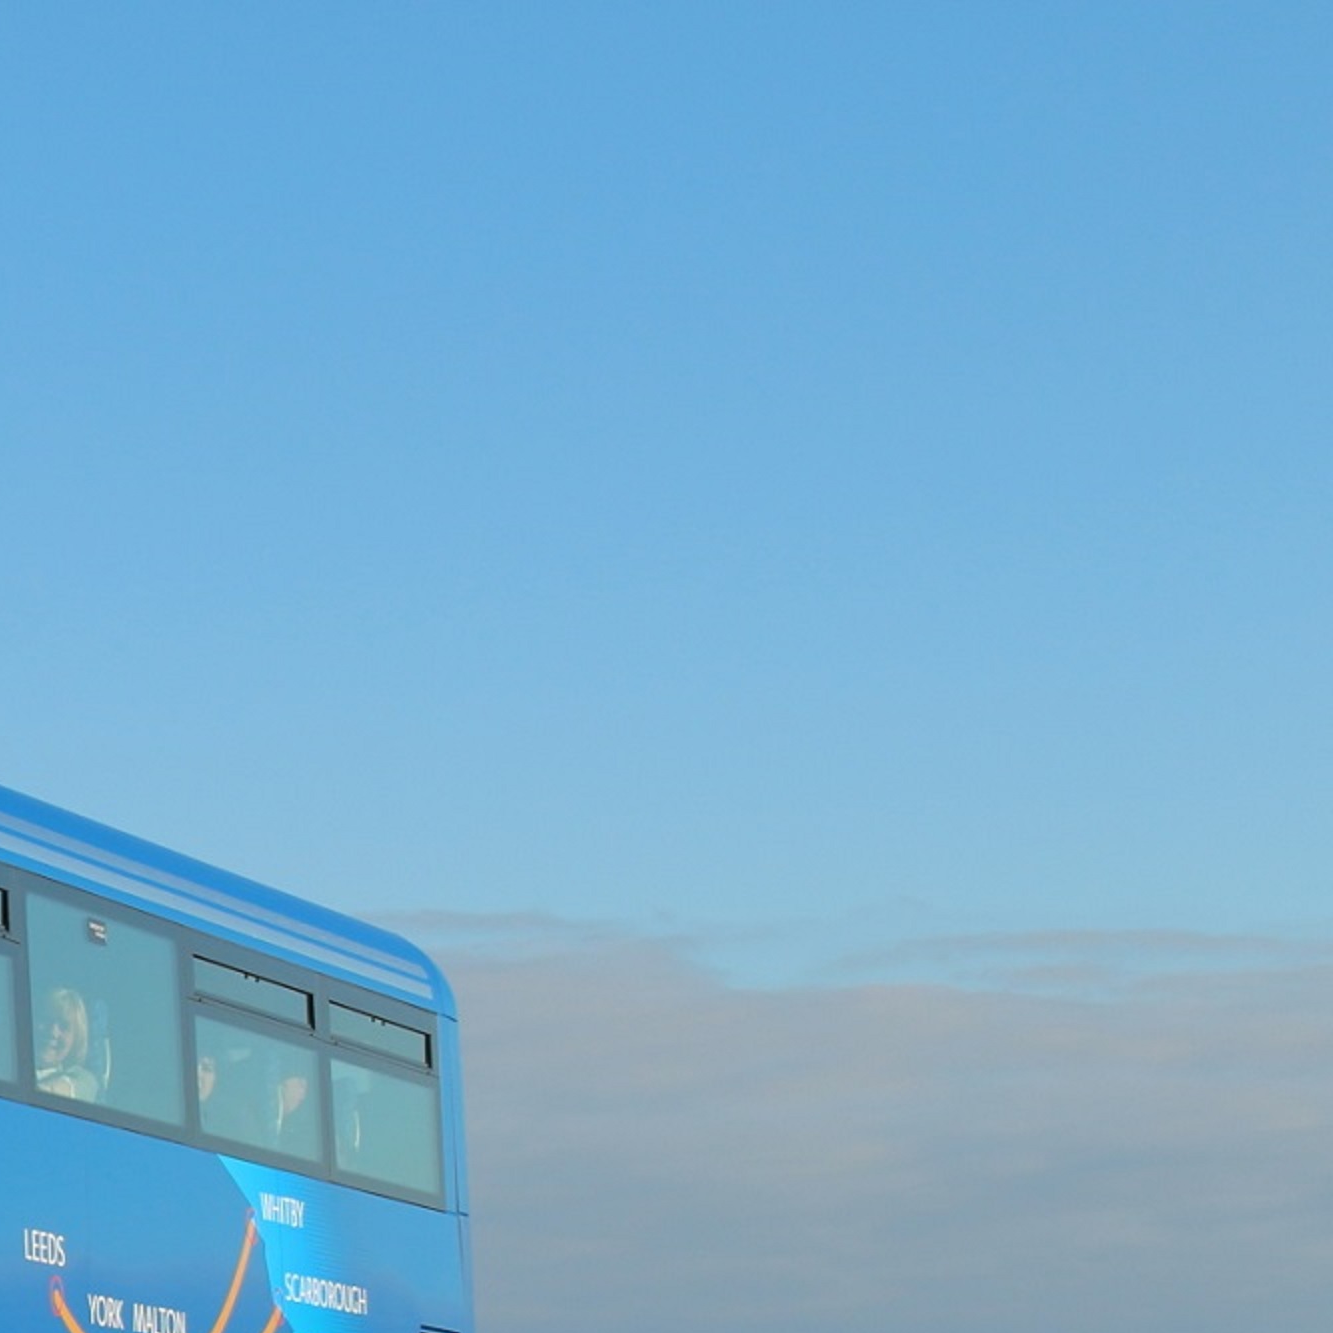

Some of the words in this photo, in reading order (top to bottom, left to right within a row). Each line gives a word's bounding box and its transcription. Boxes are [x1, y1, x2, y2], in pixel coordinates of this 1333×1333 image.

[259, 1192, 306, 1229] WHITBY
[23, 1228, 66, 1267] LEEDS
[87, 1292, 124, 1331] YORK
[284, 1272, 368, 1316] SCARBOROUGH
